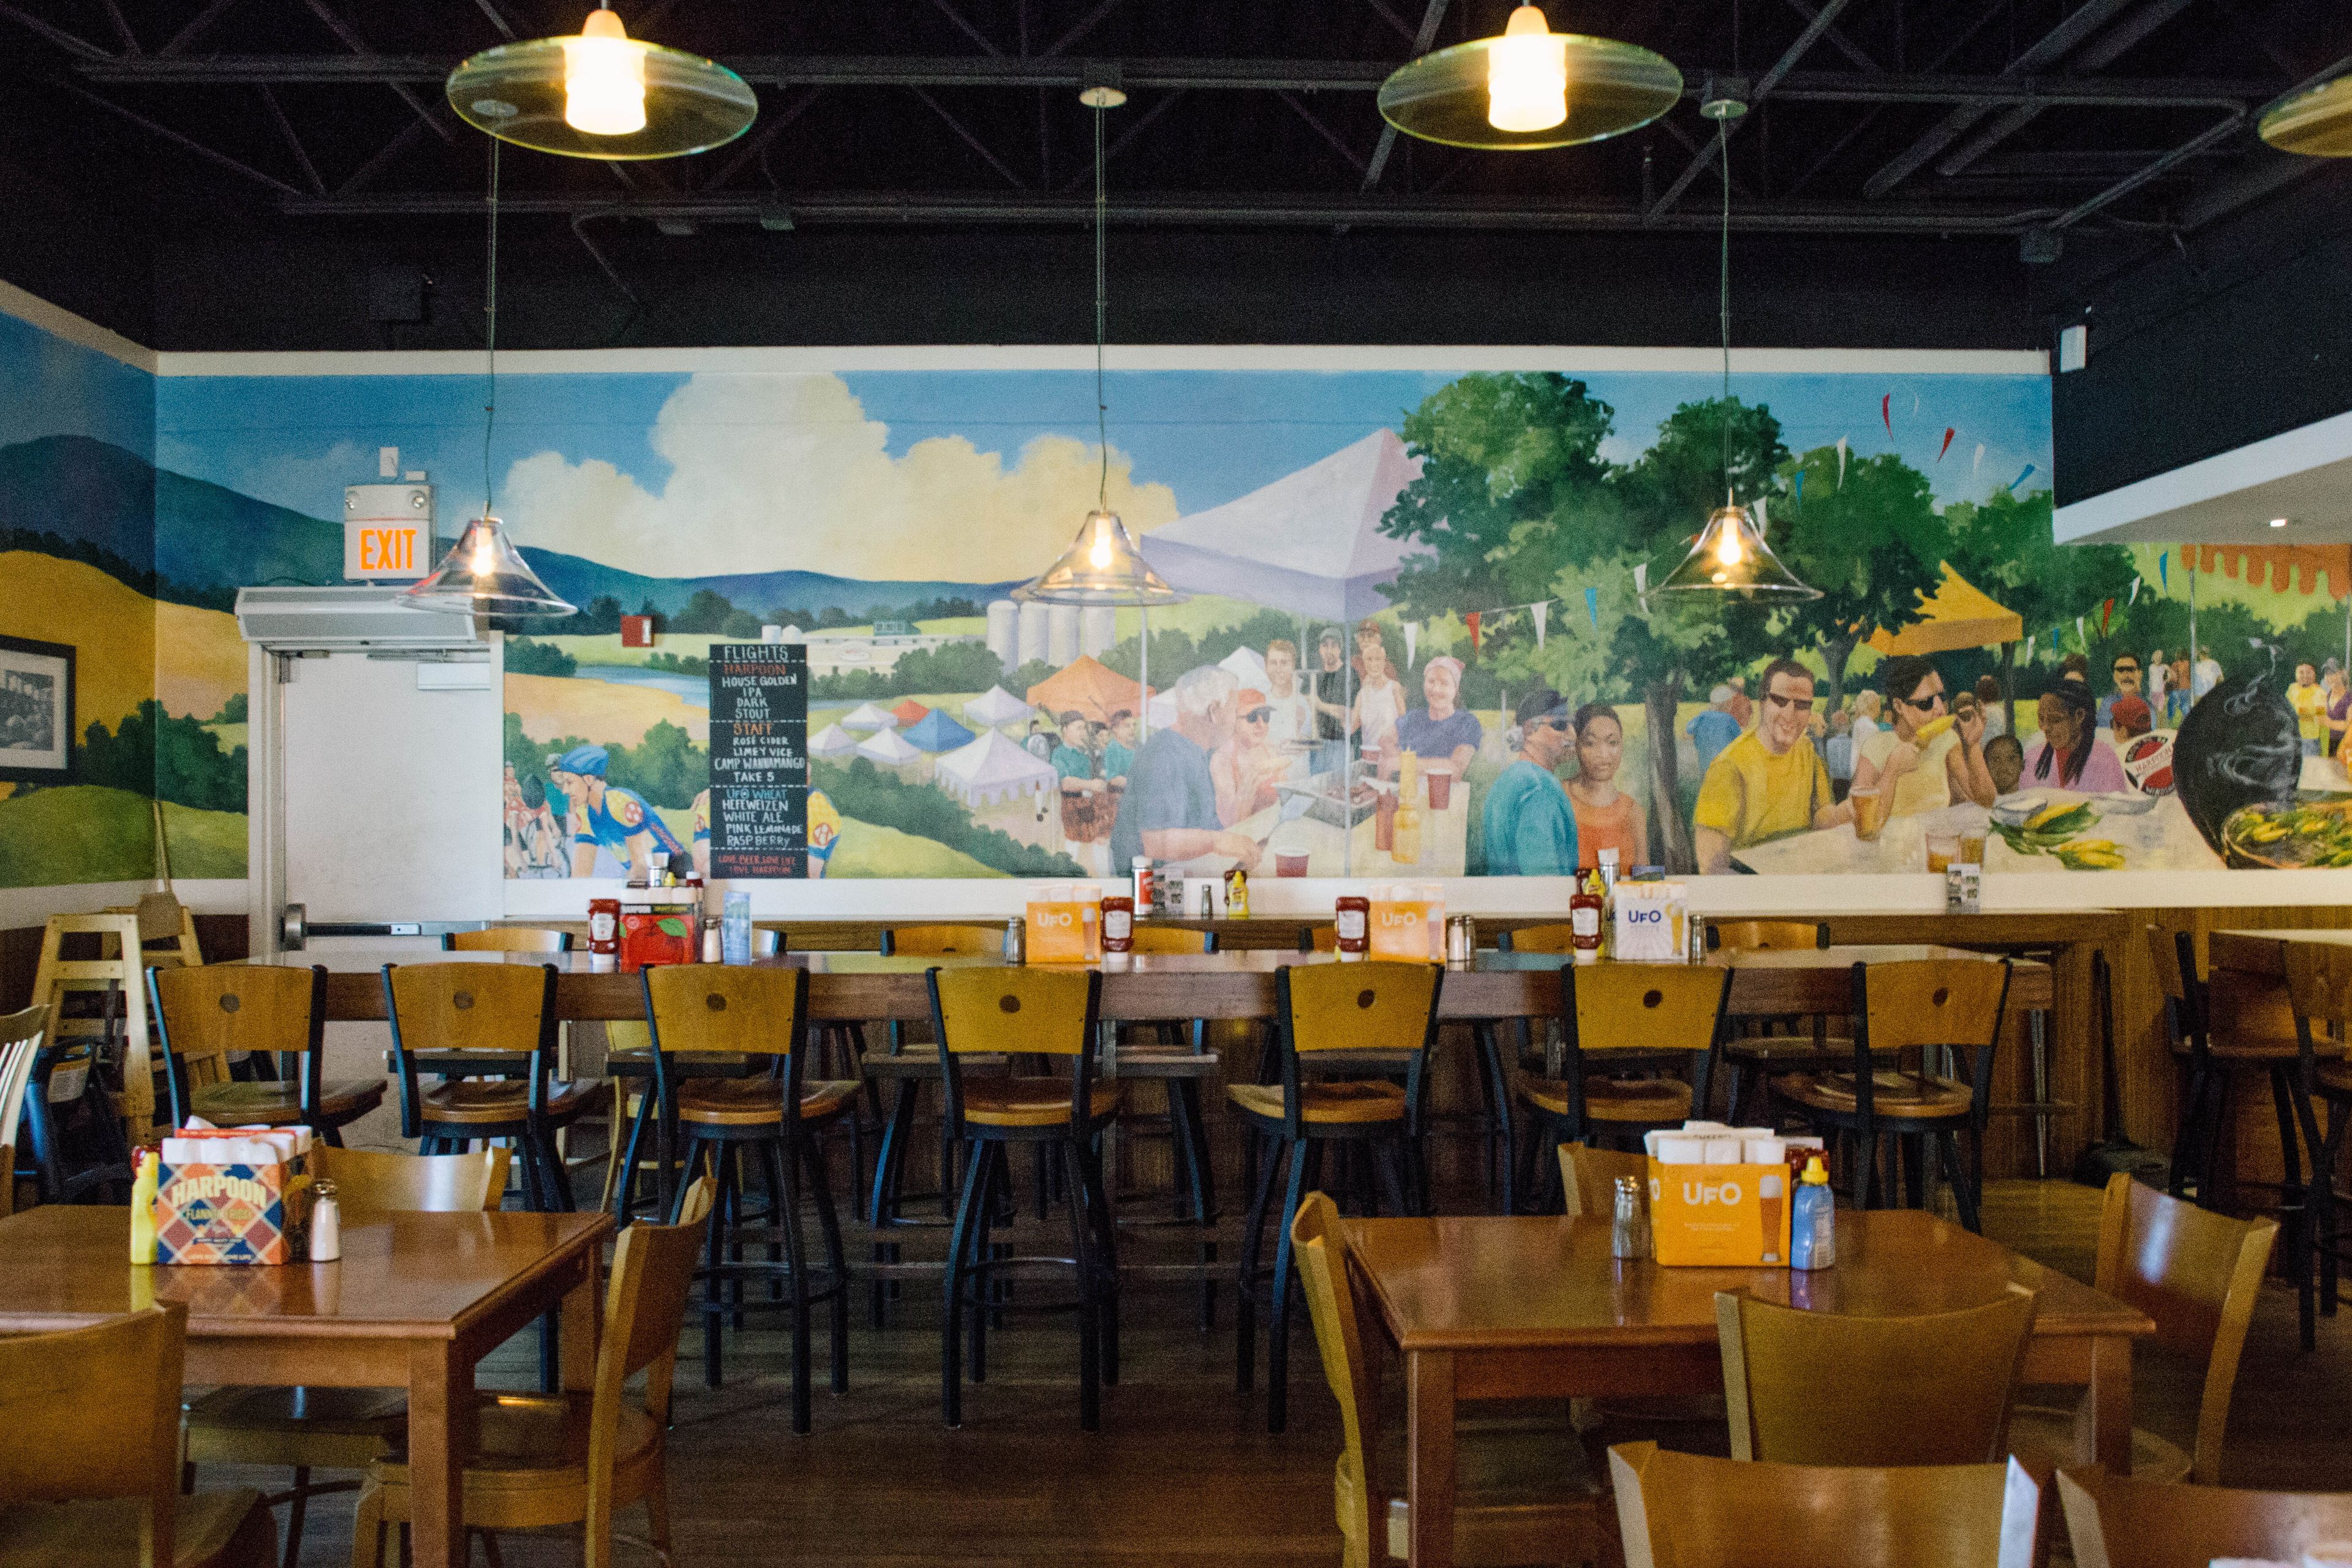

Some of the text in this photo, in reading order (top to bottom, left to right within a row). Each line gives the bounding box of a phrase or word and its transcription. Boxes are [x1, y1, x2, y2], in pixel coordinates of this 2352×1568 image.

[360, 529, 417, 570] EXIT
[724, 646, 788, 661] FLIGHTS
[724, 664, 786, 675] HARPOON
[722, 674, 797, 687] HOUSE GOLDEN
[742, 687, 763, 697] IPA
[737, 698, 768, 707] DARK
[735, 708, 771, 719] STOUT
[733, 723, 773, 735] STAFF
[733, 747, 793, 757] LIMEY VICE
[714, 758, 741, 771] CAMP
[734, 772, 775, 782] TAKE 5
[752, 790, 788, 799] WHEAT
[722, 800, 789, 811] HEFEWEIZEN
[723, 812, 783, 823] WHITE ALE
[726, 824, 803, 834] PINK LEMONADE
[1037, 913, 1072, 927] UFO
[1381, 912, 1417, 927] UFO
[1628, 910, 1661, 923] UFO
[172, 1175, 266, 1209] HARPOON
[1683, 1182, 1742, 1205] UFO
